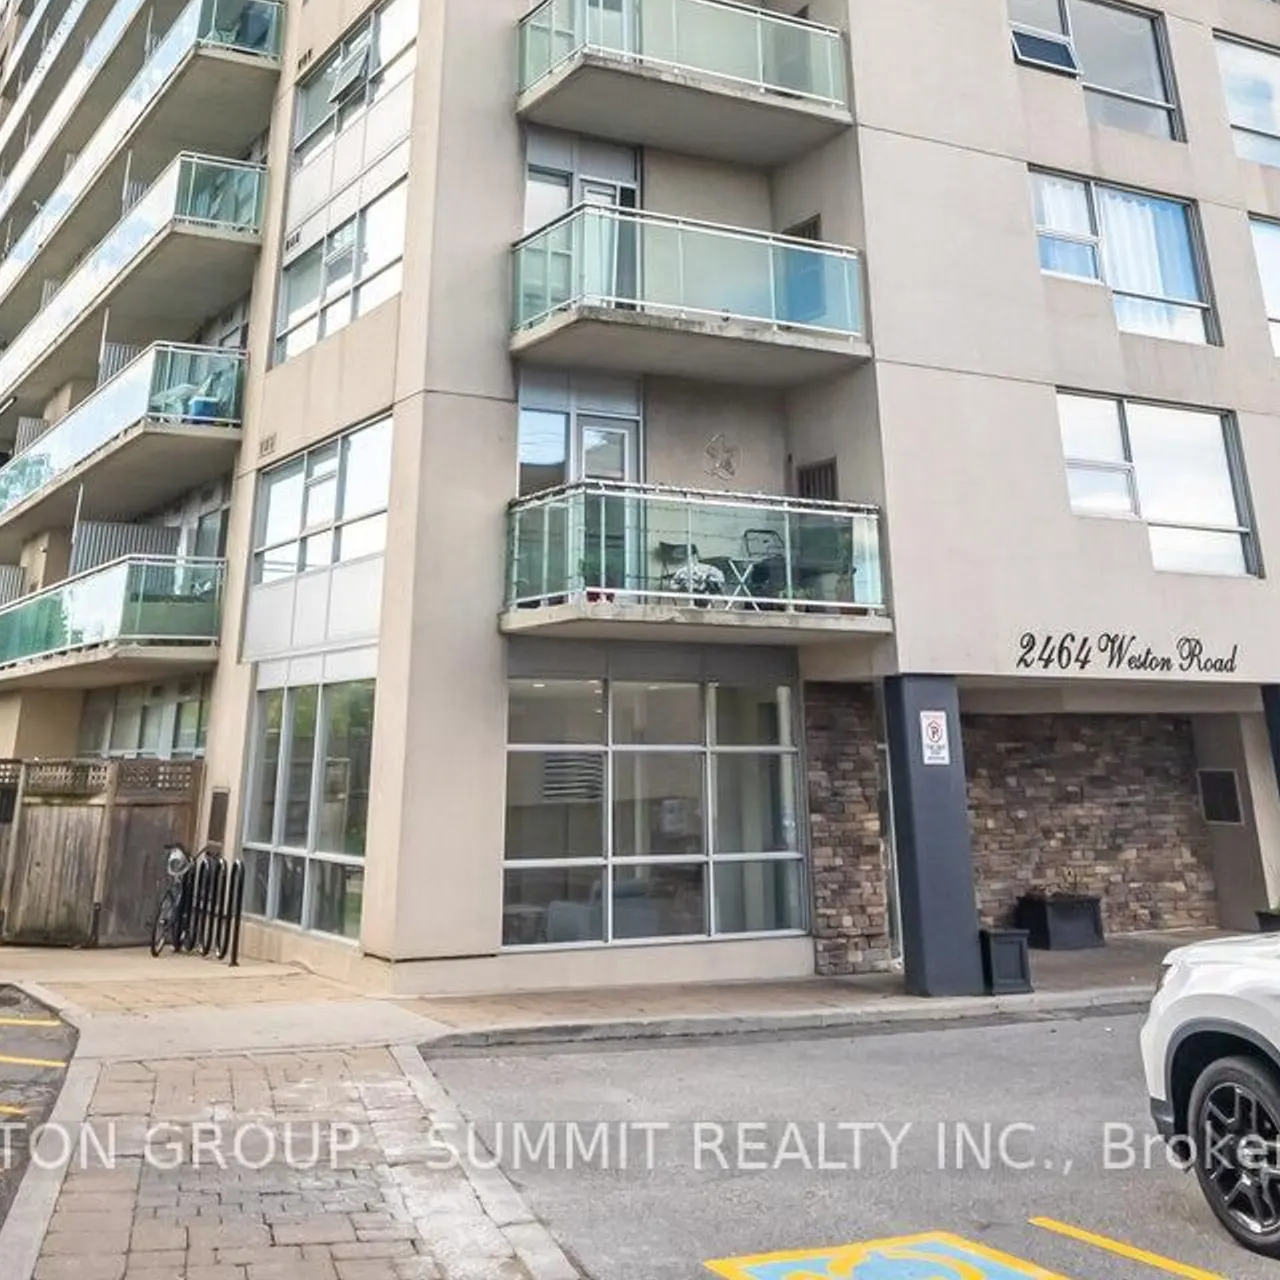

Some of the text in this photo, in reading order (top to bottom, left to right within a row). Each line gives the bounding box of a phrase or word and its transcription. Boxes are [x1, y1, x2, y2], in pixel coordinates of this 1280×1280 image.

[1017, 632, 1238, 672] 2464 Weston Road
